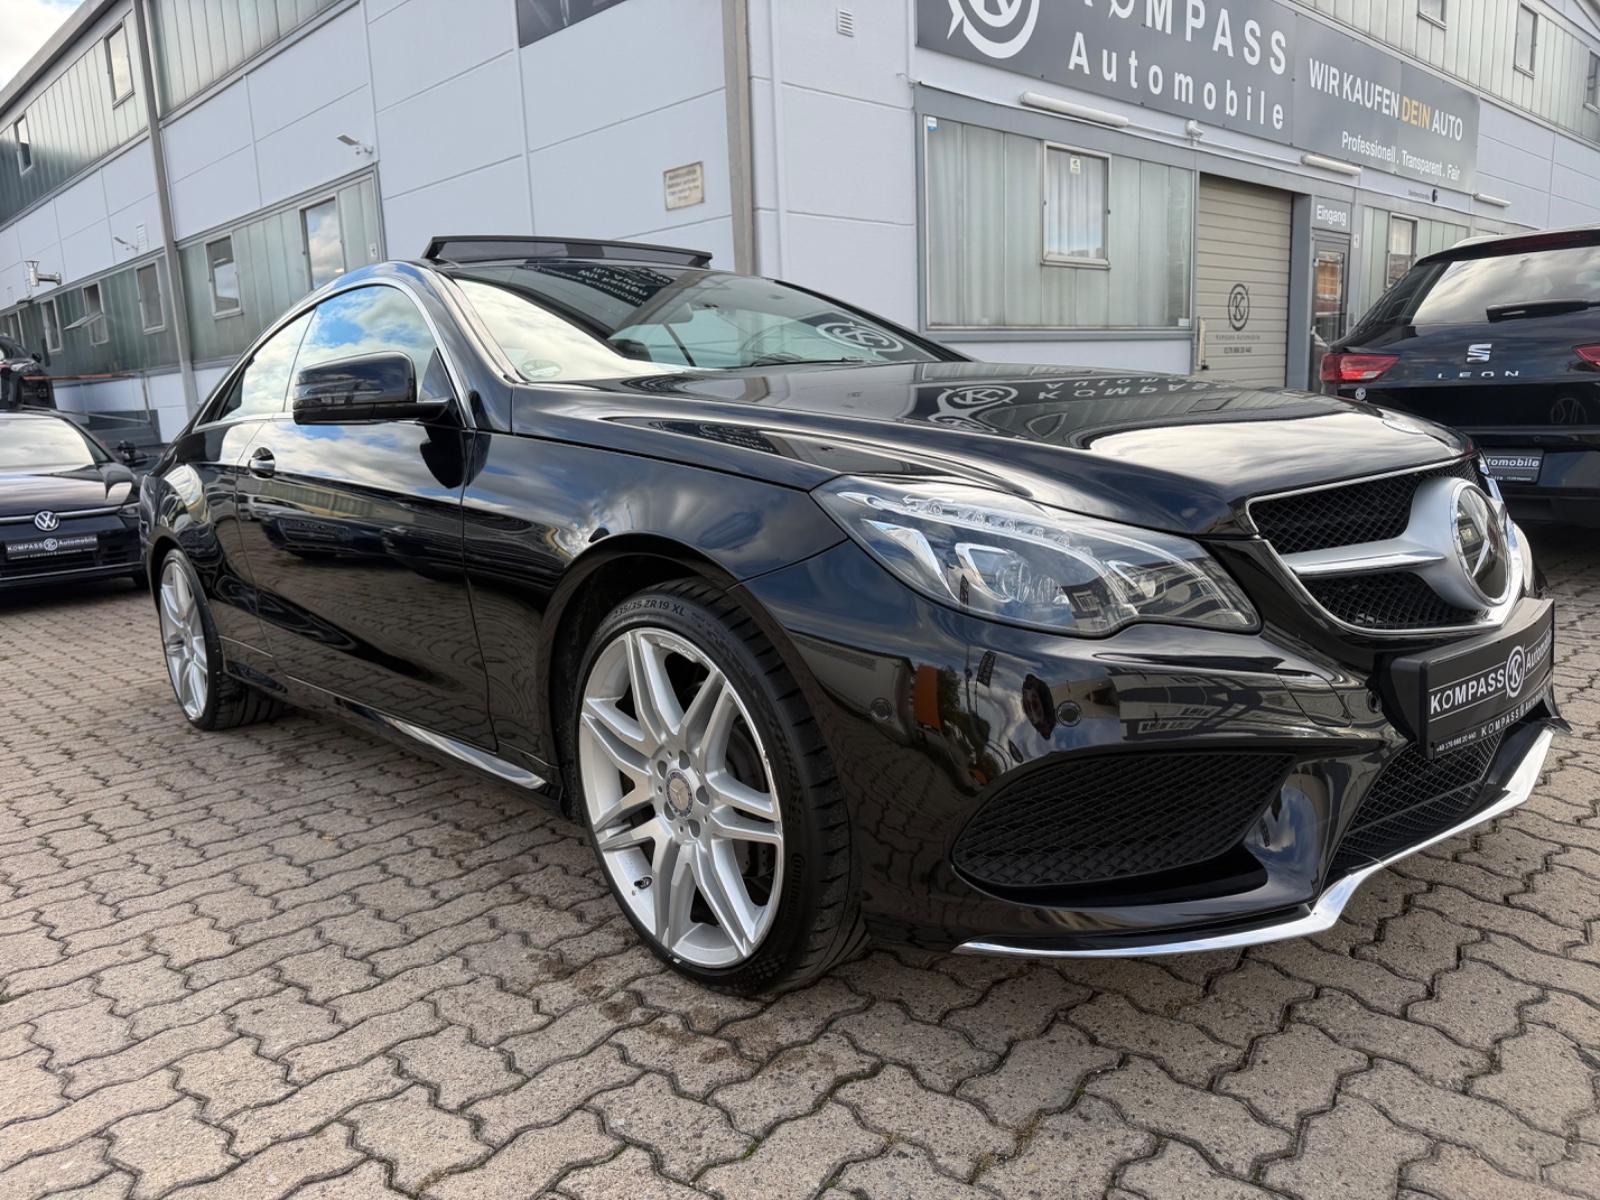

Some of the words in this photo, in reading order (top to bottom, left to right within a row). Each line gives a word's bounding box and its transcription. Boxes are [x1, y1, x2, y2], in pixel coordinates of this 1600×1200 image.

[1084, 0, 1287, 75] MPASS
[1068, 31, 1285, 130] Automobile
[1309, 58, 1340, 97] WIR
[1343, 72, 1400, 119] KAUFEN
[1402, 96, 1432, 130] DEIN
[1432, 109, 1464, 142] AUTO
[1316, 204, 1347, 226] Eingang
[1437, 370, 1519, 380] LEON
[1486, 456, 1540, 468] tomobile
[659, 601, 670, 610] 19
[671, 603, 685, 617] XL
[1480, 708, 1519, 737] KOMPASS
